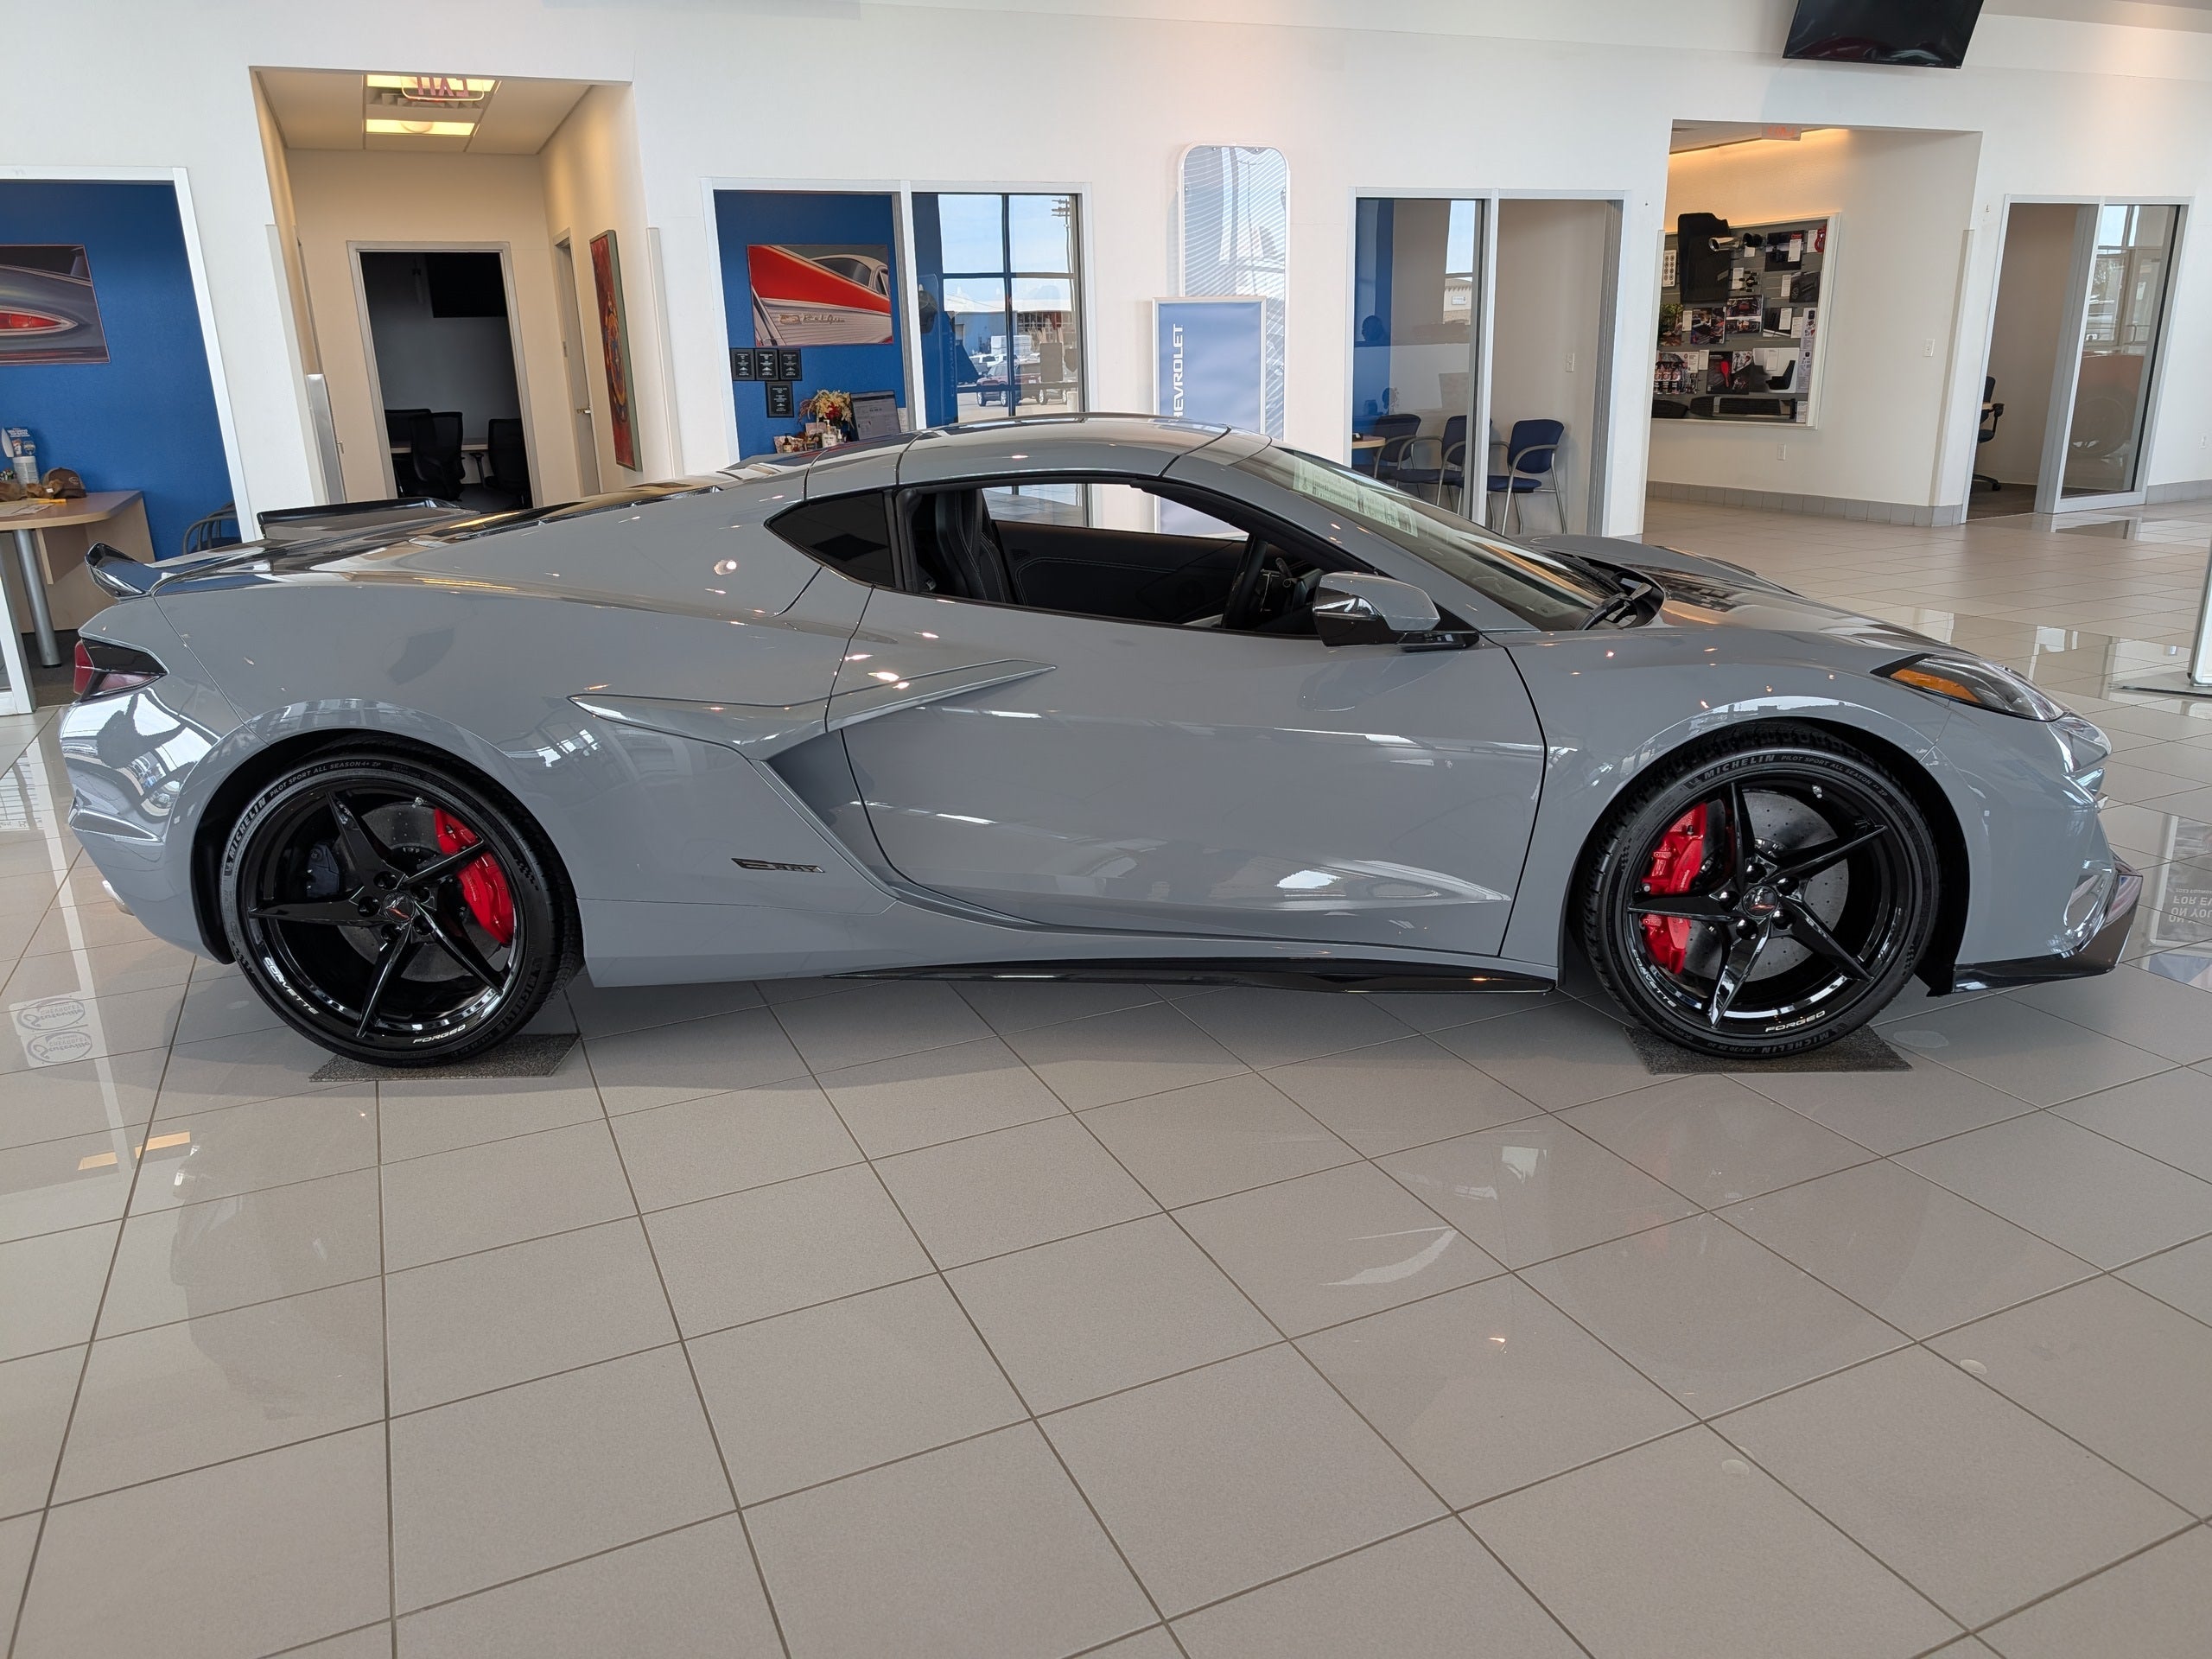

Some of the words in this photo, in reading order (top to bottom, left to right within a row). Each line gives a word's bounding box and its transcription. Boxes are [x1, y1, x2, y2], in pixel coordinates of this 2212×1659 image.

[1173, 323, 1184, 418] HEVROLET
[270, 782, 287, 797] PILOT
[289, 771, 311, 784] SPORT
[313, 766, 327, 774] ALL
[329, 760, 361, 770] SEASON
[1704, 754, 1775, 779] MICHELIN
[1804, 757, 1831, 766] SPORT
[1845, 768, 1872, 785] SEASON
[228, 797, 266, 859] MICHELIN
[264, 957, 319, 1014] CORVETTE
[1632, 949, 1676, 1007] CORVETTE
[413, 1024, 466, 1044] FORGED
[1765, 1010, 1826, 1033] FORGED
[1761, 1031, 1829, 1054] MICHELIN
